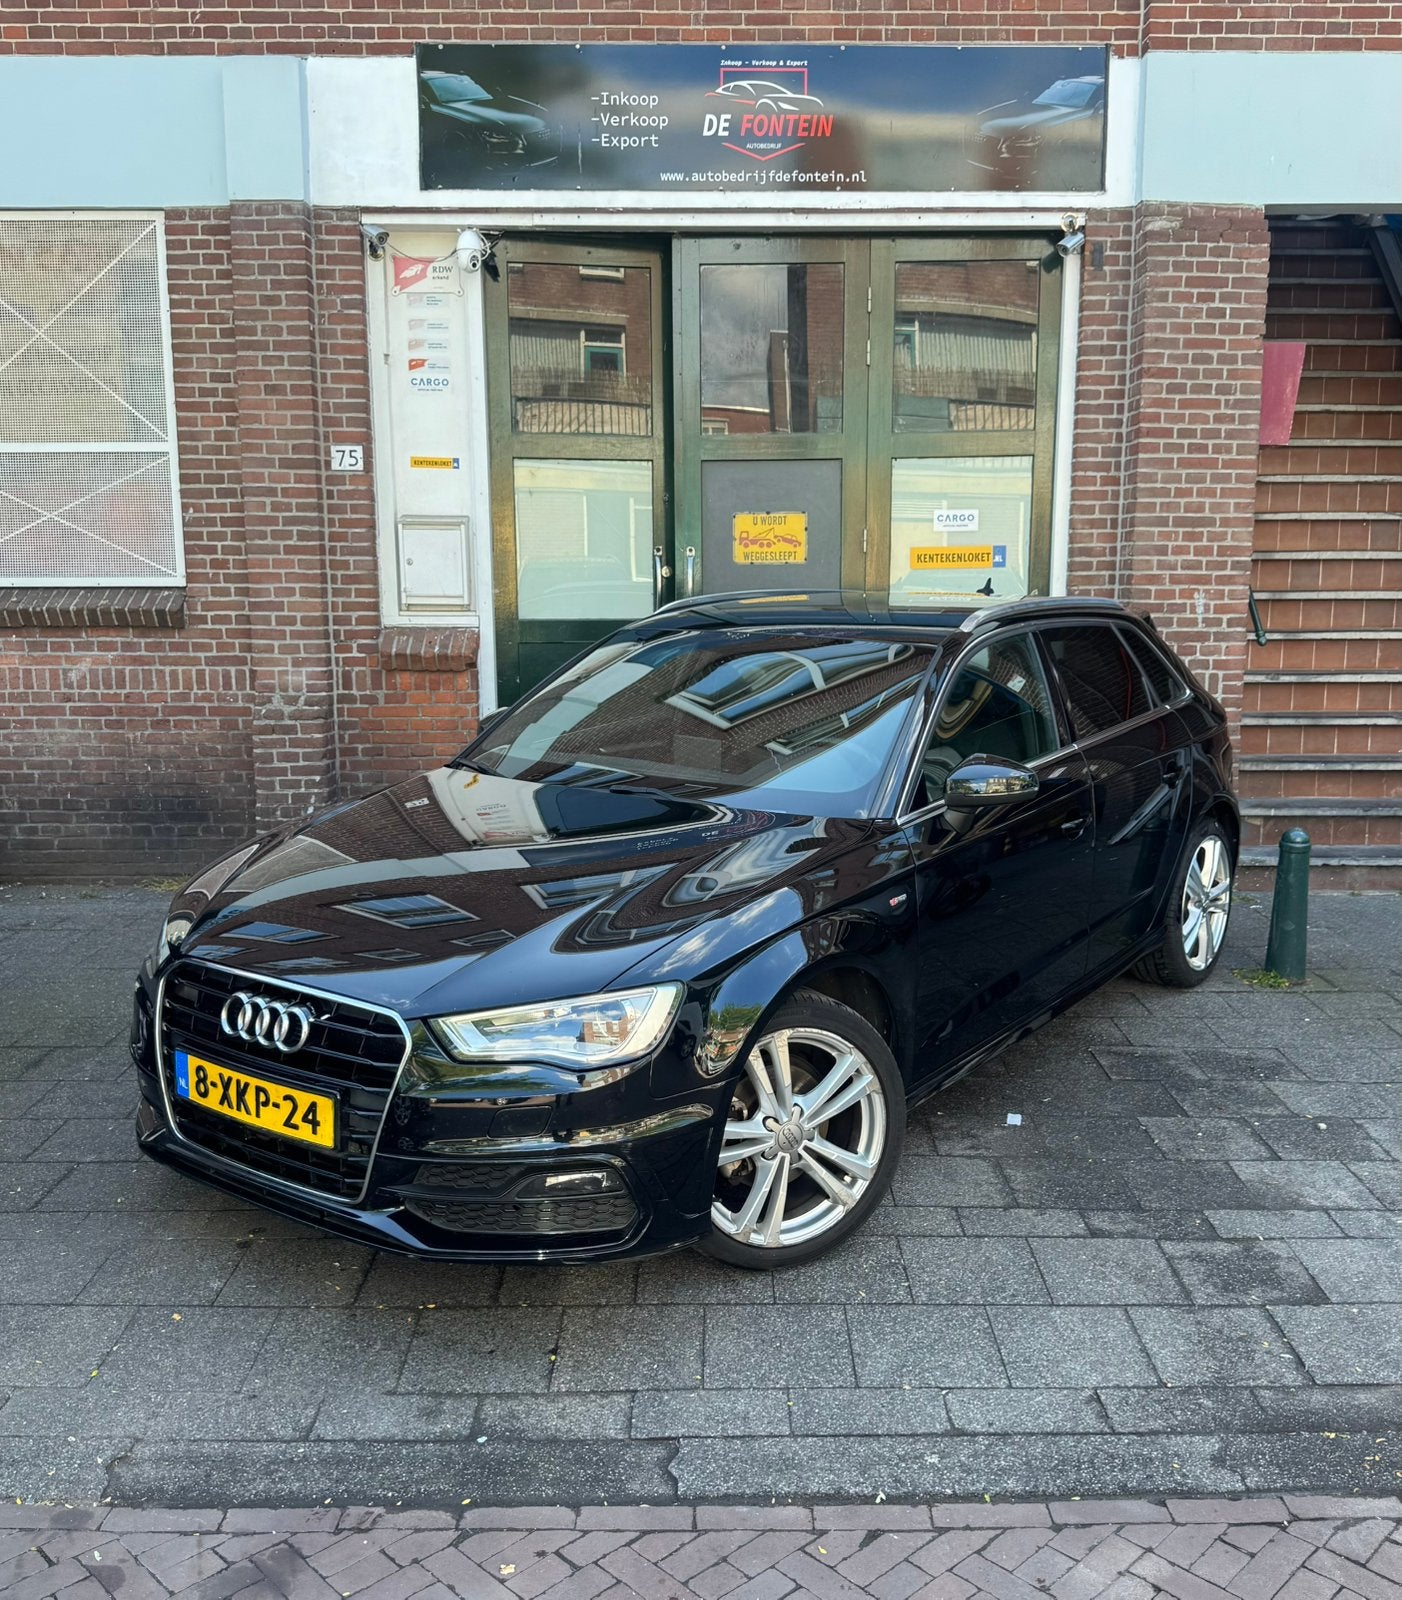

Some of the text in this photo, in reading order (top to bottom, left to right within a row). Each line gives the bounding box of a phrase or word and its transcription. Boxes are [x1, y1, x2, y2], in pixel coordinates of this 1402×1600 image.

[591, 91, 659, 109] -Inkoop
[591, 112, 669, 130] -Verkoop
[702, 113, 834, 137] DE FONTEIN
[591, 133, 659, 150] -Export
[660, 170, 867, 184] www.autobedrijfdefontein.nl
[432, 265, 453, 273] RDW
[410, 377, 449, 386] CARGO
[335, 449, 359, 467] 75
[752, 515, 787, 526] U WORDT
[937, 513, 975, 522] CARGO
[743, 551, 798, 561] WEGGESLEEPT
[916, 552, 991, 564] KENTEKENLOKET
[178, 1065, 321, 1136] NL 8-XKP-24
